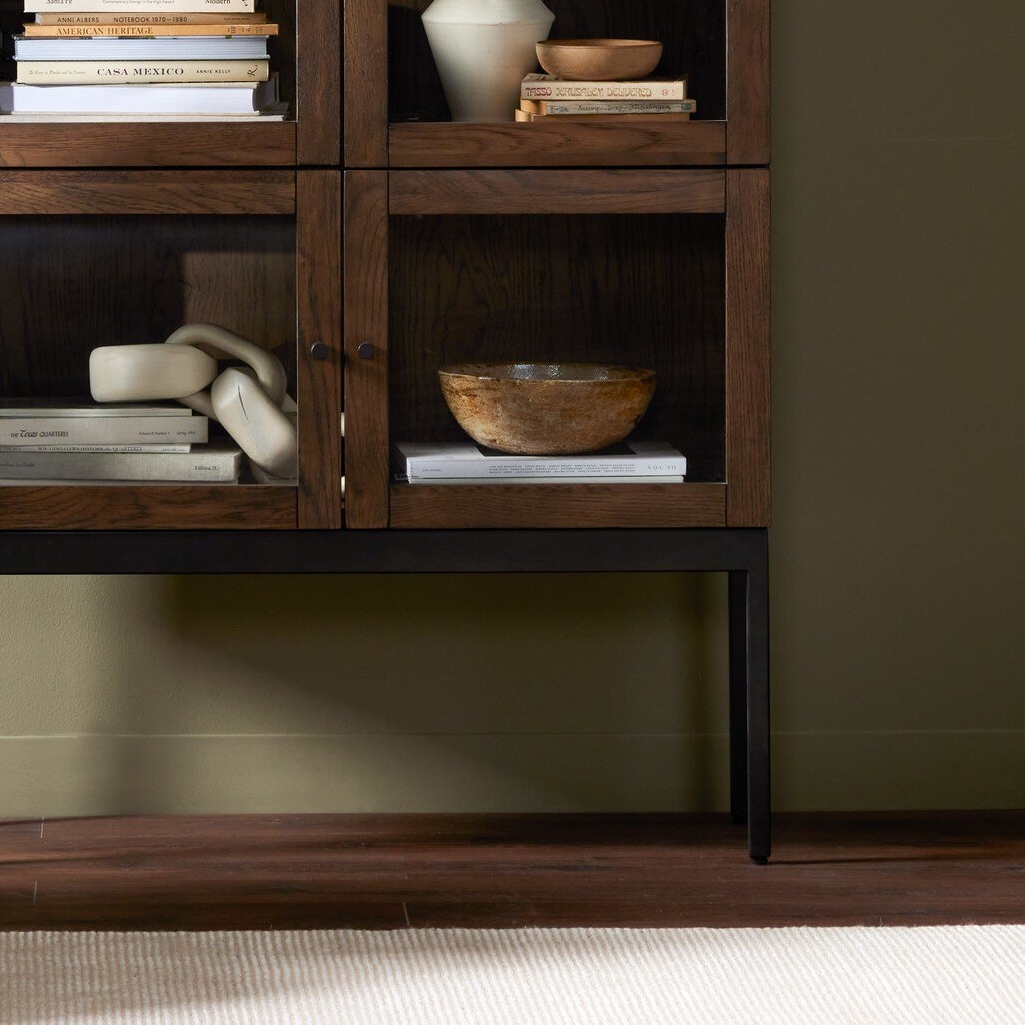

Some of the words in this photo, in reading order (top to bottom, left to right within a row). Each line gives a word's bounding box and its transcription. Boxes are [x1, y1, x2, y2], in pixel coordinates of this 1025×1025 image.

[107, 27, 154, 35] HERITAGE
[97, 68, 128, 76] CASA
[133, 67, 184, 76] MEXICO
[525, 87, 552, 96] TASSO
[606, 87, 652, 97] DELIVERED
